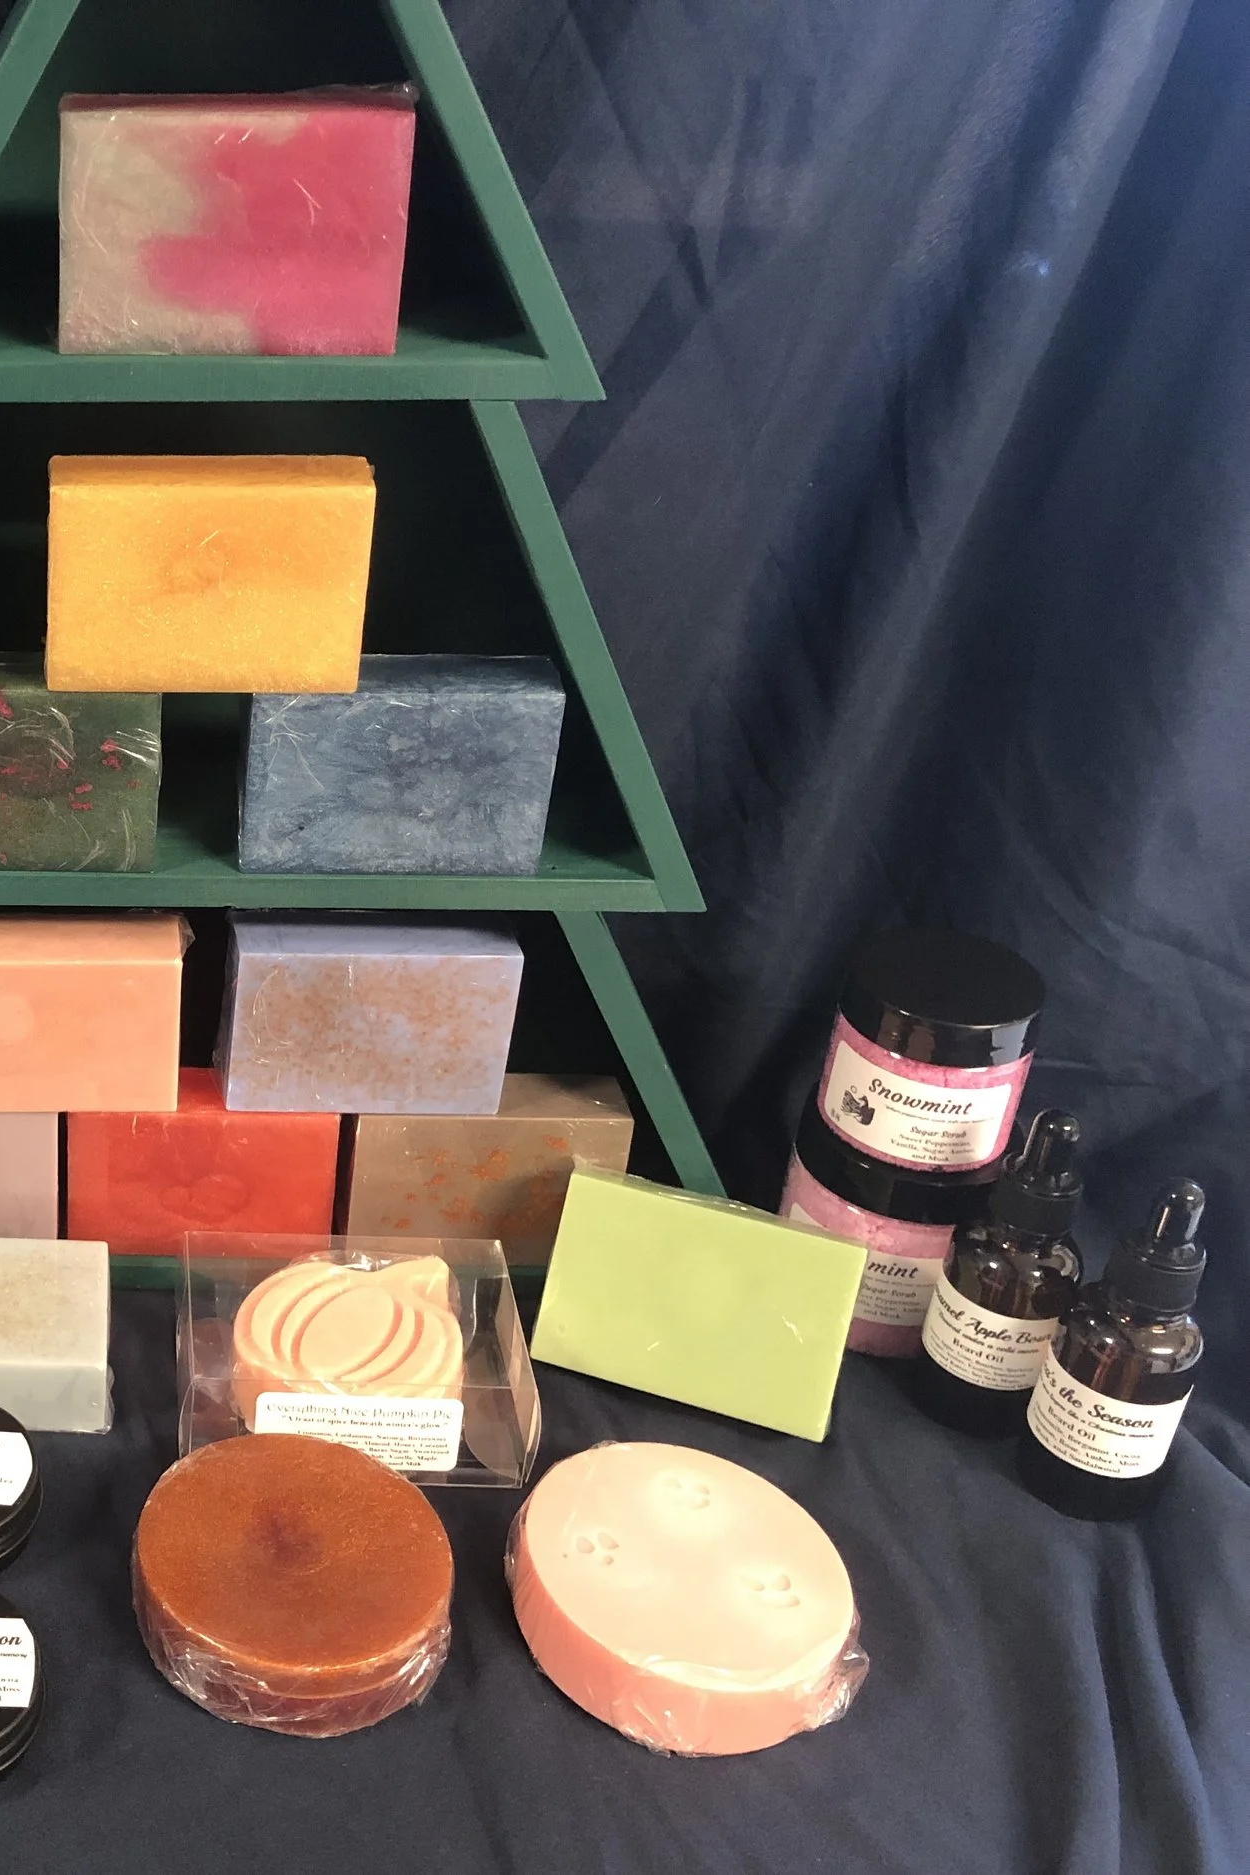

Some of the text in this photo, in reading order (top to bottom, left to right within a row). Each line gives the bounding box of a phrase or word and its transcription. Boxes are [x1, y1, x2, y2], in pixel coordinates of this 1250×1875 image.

[868, 1078, 972, 1115] Snowmint
[965, 1317, 1012, 1342] Apple
[952, 1338, 1004, 1363] Beard Oil
[267, 1404, 337, 1416] Everything
[1048, 1406, 1075, 1432] Beard
[1077, 1428, 1096, 1441] Oil
[1059, 1387, 1082, 1409] the
[1087, 1404, 1154, 1430] Season
